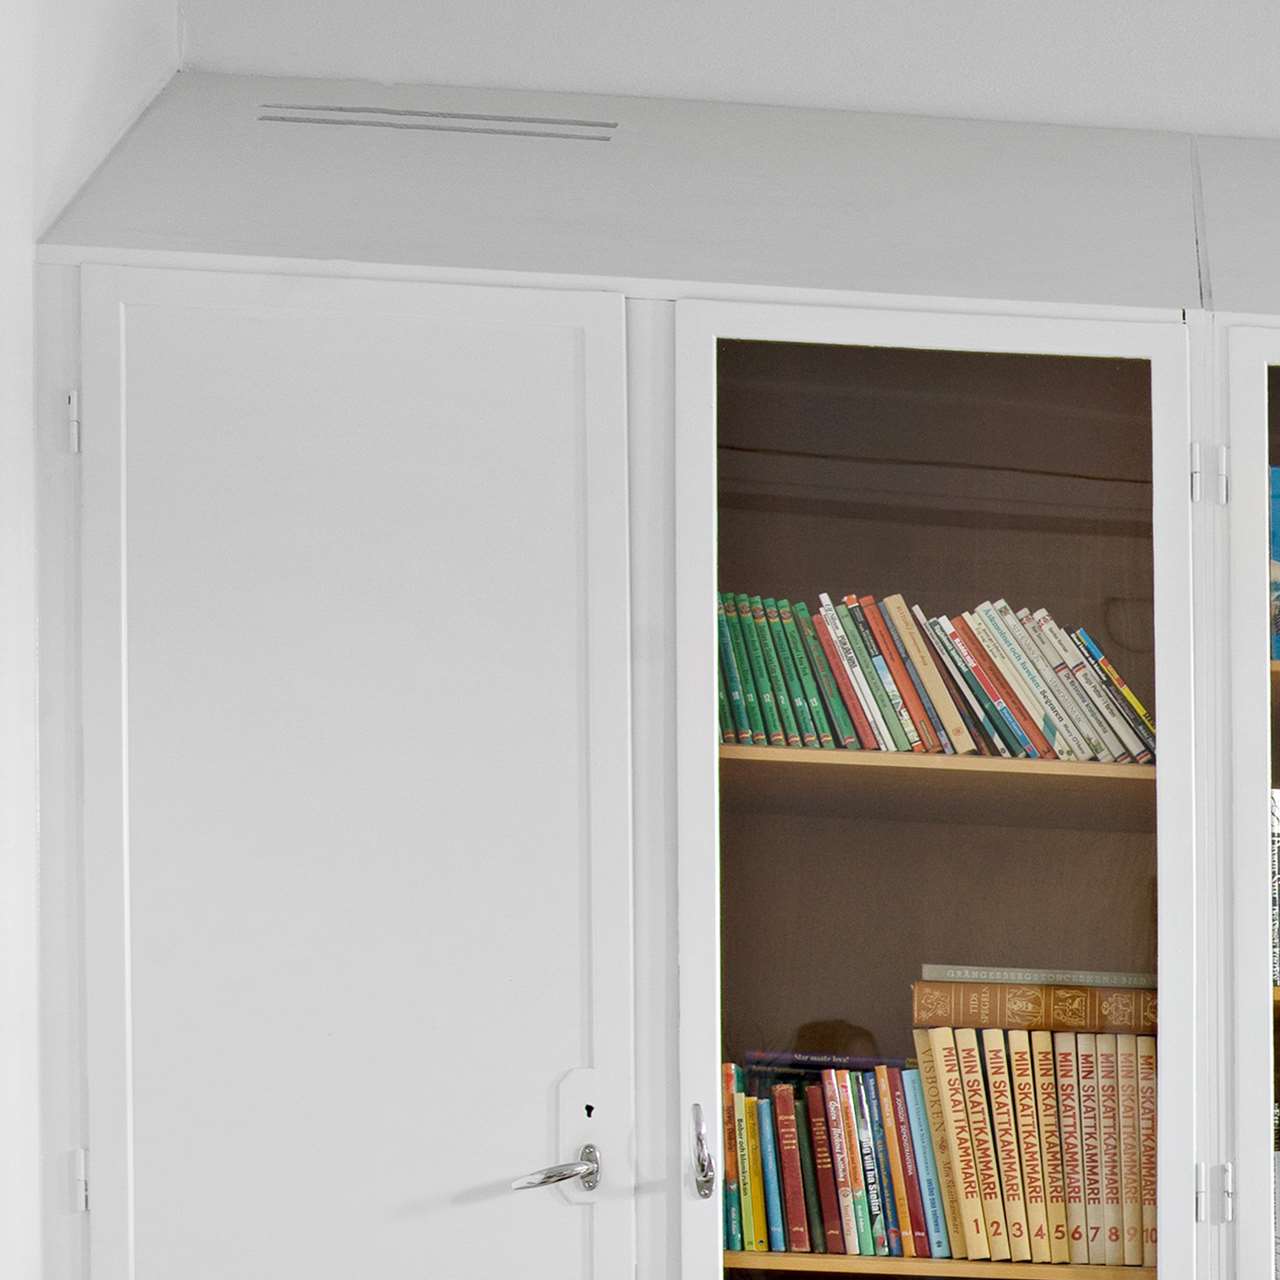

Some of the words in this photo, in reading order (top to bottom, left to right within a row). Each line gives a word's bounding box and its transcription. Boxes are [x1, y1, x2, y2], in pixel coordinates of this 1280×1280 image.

[942, 1046, 958, 1072] MIN
[961, 1048, 977, 1074] MIN
[988, 1049, 1004, 1075] MIN
[1014, 1051, 1030, 1077] MIN
[1038, 1051, 1053, 1077] MIN
[1058, 1052, 1073, 1078] MIN
[1081, 1054, 1094, 1079] MIN
[1100, 1053, 1115, 1080] MIN
[1120, 1053, 1135, 1079] MIN
[1140, 1055, 1154, 1080] MIN
[920, 1048, 945, 1134] VISBOKEN
[947, 1078, 978, 1199] SKATTKAMMARE
[966, 1079, 997, 1200] SKATTKAMMARE
[993, 1081, 1020, 1201] SKATTKAMMARE
[1018, 1083, 1043, 1204] SKATTKAMMARE
[1041, 1083, 1063, 1203] SKATTKAMMARE
[1060, 1084, 1082, 1204] SKATTKAMMARE
[1082, 1085, 1100, 1205] SKATTKAMMARE
[1101, 1085, 1119, 1204] SKATTKAMMARE
[1122, 1084, 1138, 1204] SKATTKAMMARE
[1141, 1086, 1156, 1205] SKATTKAMMARE
[973, 1218, 981, 1234] 1
[991, 1221, 1002, 1237] 2
[1012, 1222, 1024, 1238] 3
[1034, 1224, 1046, 1239] 4
[1054, 1224, 1065, 1240] 5
[1071, 1225, 1083, 1241] 6
[1090, 1226, 1100, 1242] 7
[1108, 1227, 1120, 1242] 8
[1127, 1228, 1138, 1242] 9
[1144, 1228, 1157, 1243] 10
